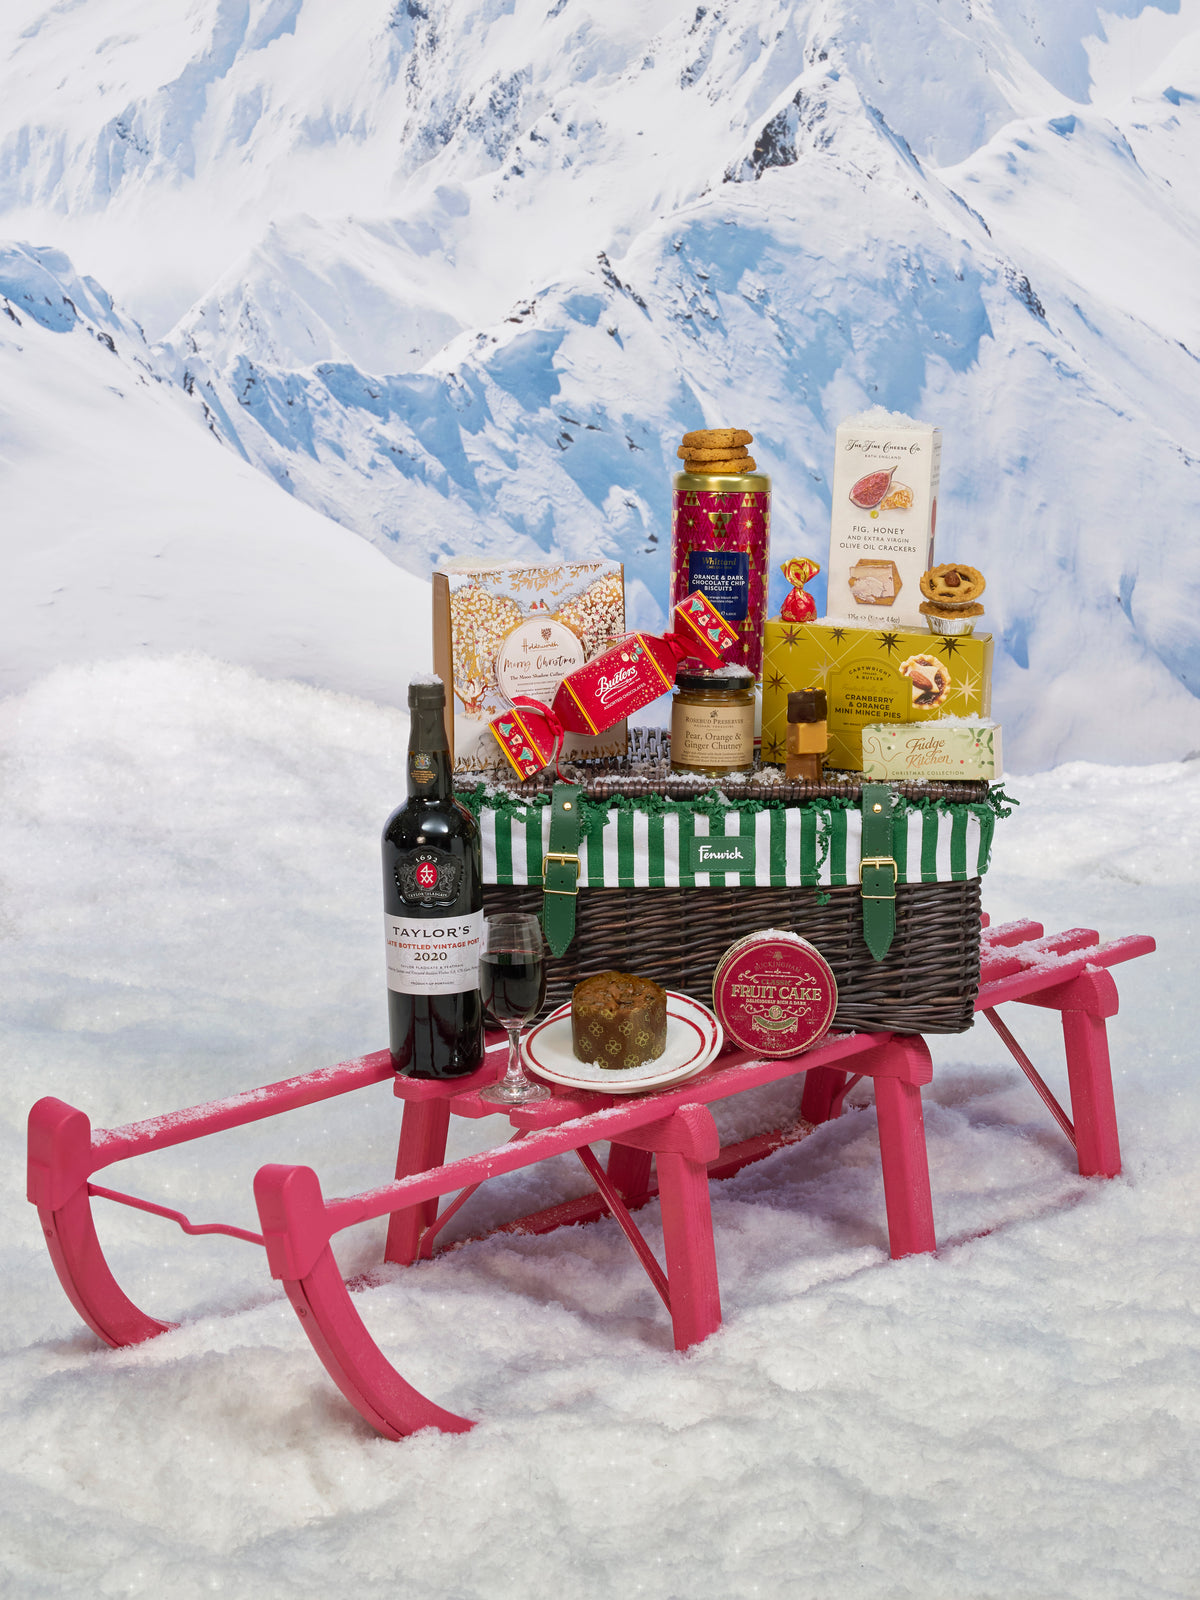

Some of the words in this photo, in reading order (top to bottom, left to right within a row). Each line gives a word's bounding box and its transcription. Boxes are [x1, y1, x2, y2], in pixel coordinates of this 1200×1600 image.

[852, 525, 870, 533] FIG,
[873, 527, 905, 535] HONEY
[839, 542, 861, 550] OLIVE
[878, 545, 917, 553] CRACKERS
[503, 658, 531, 672] Merry
[536, 654, 576, 670] Christmas
[849, 666, 891, 678] CARTWRIGHT
[595, 665, 638, 697] Butlers
[845, 693, 894, 704] CRANBERRY
[856, 702, 890, 711] ORANGE
[855, 709, 881, 717] MINCE
[883, 711, 902, 719] PIES
[685, 730, 703, 740] Pear,
[705, 732, 733, 743] Orange
[684, 740, 709, 751] Ginger
[711, 741, 743, 750] Chutney
[905, 736, 945, 757] Fudge
[905, 753, 954, 769] Kitchen
[415, 854, 438, 863] 1692
[698, 845, 744, 863] Fenwick
[392, 925, 470, 938] TAYLOR'S
[398, 942, 431, 950] BOTTLED
[432, 941, 466, 949] VINTAGE
[467, 937, 480, 946] PORT
[414, 951, 448, 961] 2020
[761, 978, 793, 986] CLASSIC
[731, 984, 777, 998] FRUIT
[779, 986, 822, 1001] CAKE
